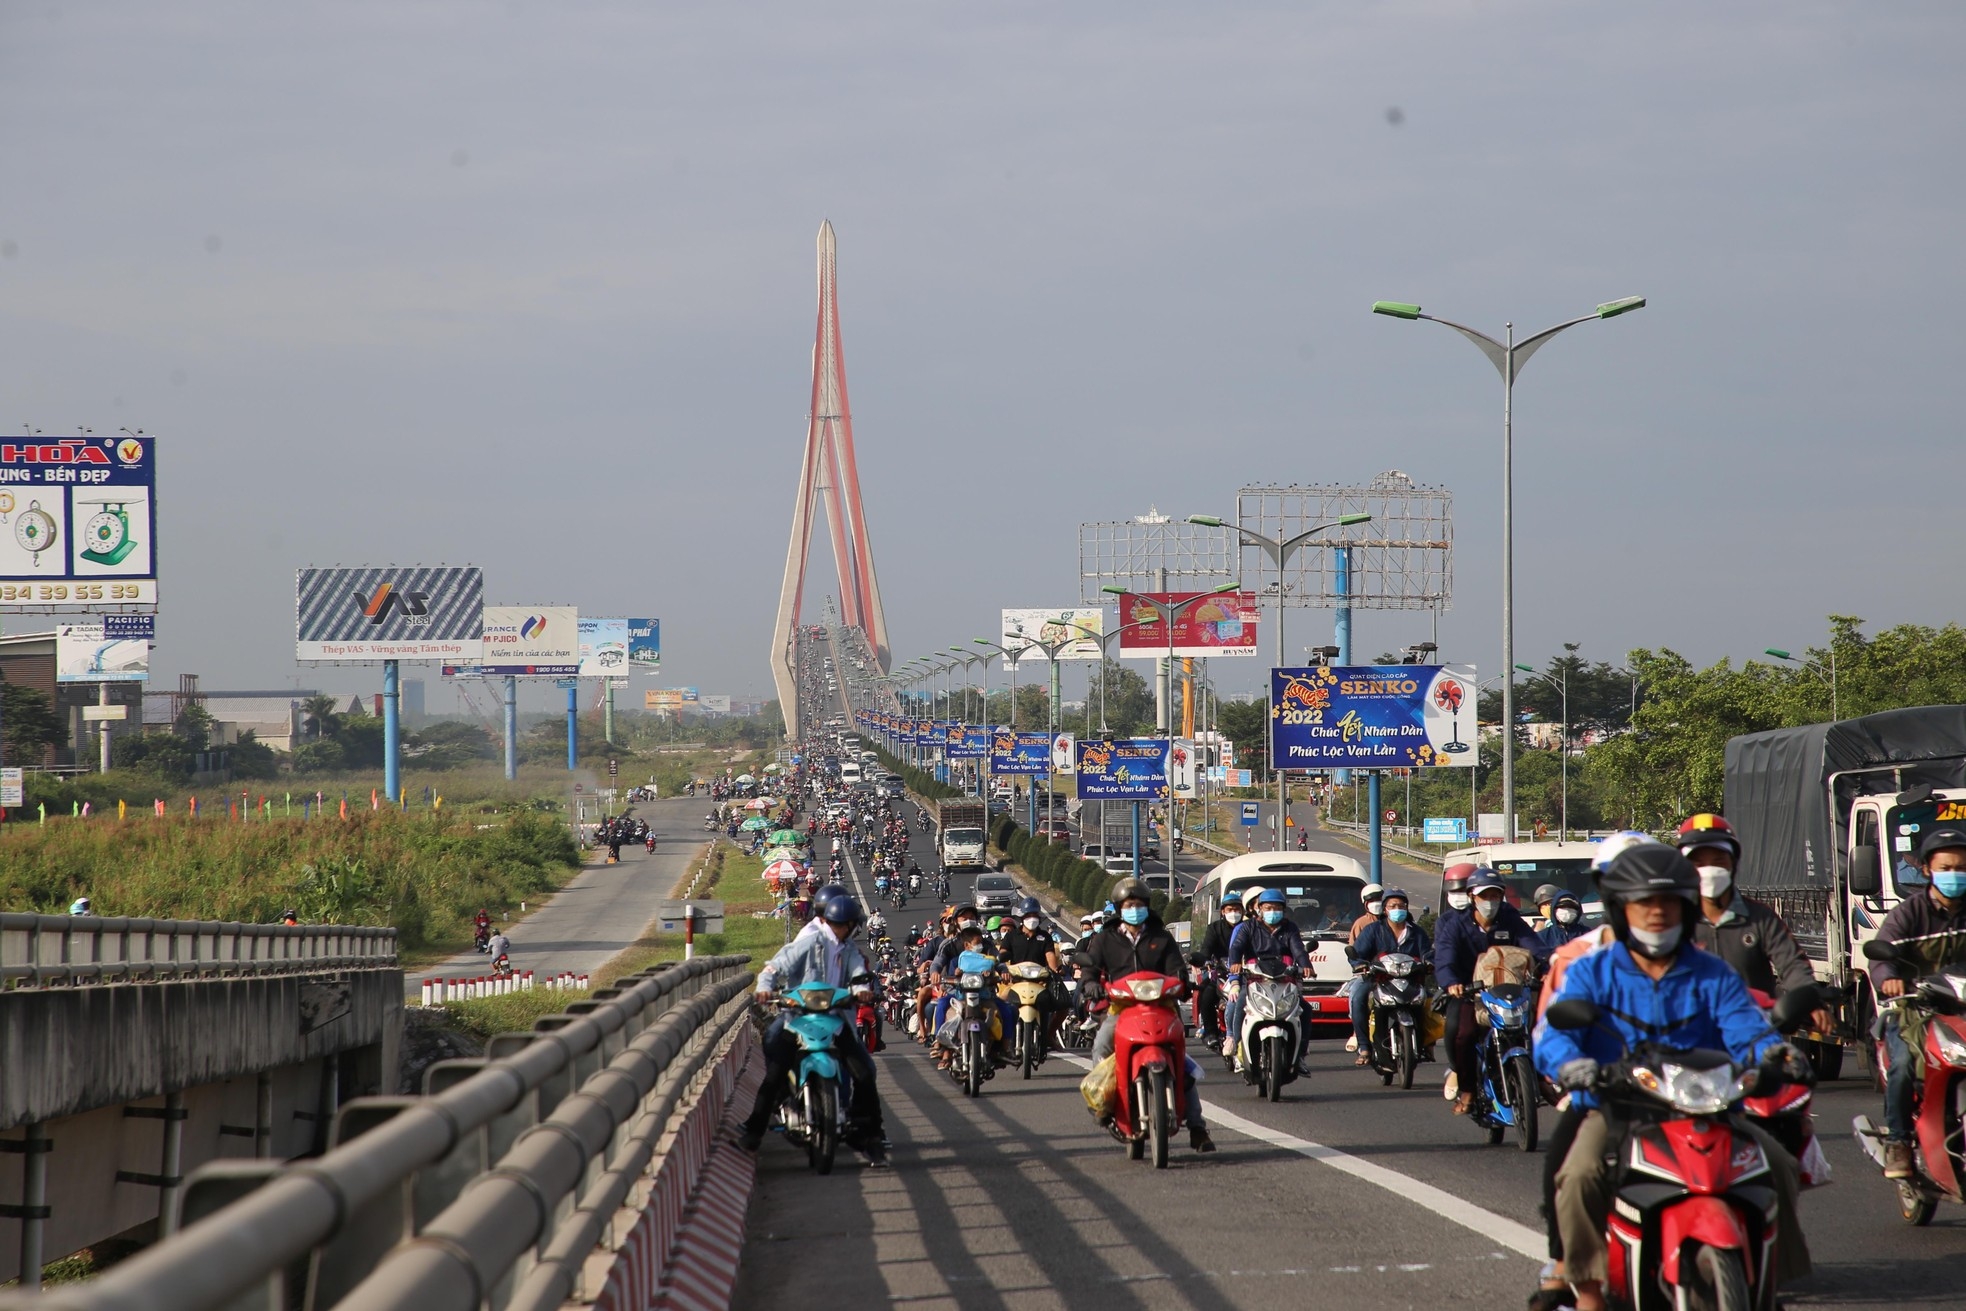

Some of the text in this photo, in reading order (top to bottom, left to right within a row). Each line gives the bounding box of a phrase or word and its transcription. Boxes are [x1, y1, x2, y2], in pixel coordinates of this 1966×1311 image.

[80, 469, 111, 484] ĐẸP
[0, 584, 140, 600] 34 39 55 39
[353, 582, 430, 625] VAS
[405, 616, 431, 626] Steel
[493, 635, 518, 643] PJICO
[347, 645, 364, 653] VAS
[513, 649, 524, 657] tin
[1340, 680, 1418, 695] SENKO
[1282, 709, 1323, 724] 2022
[1311, 725, 1340, 738] Chúc
[1116, 748, 1161, 757] SENKO
[1289, 745, 1320, 758] Phúc
[1323, 745, 1344, 759] Lộc
[1347, 745, 1371, 759] Vạn
[1083, 766, 1107, 774] 2022
[1086, 785, 1104, 793] Phúc
